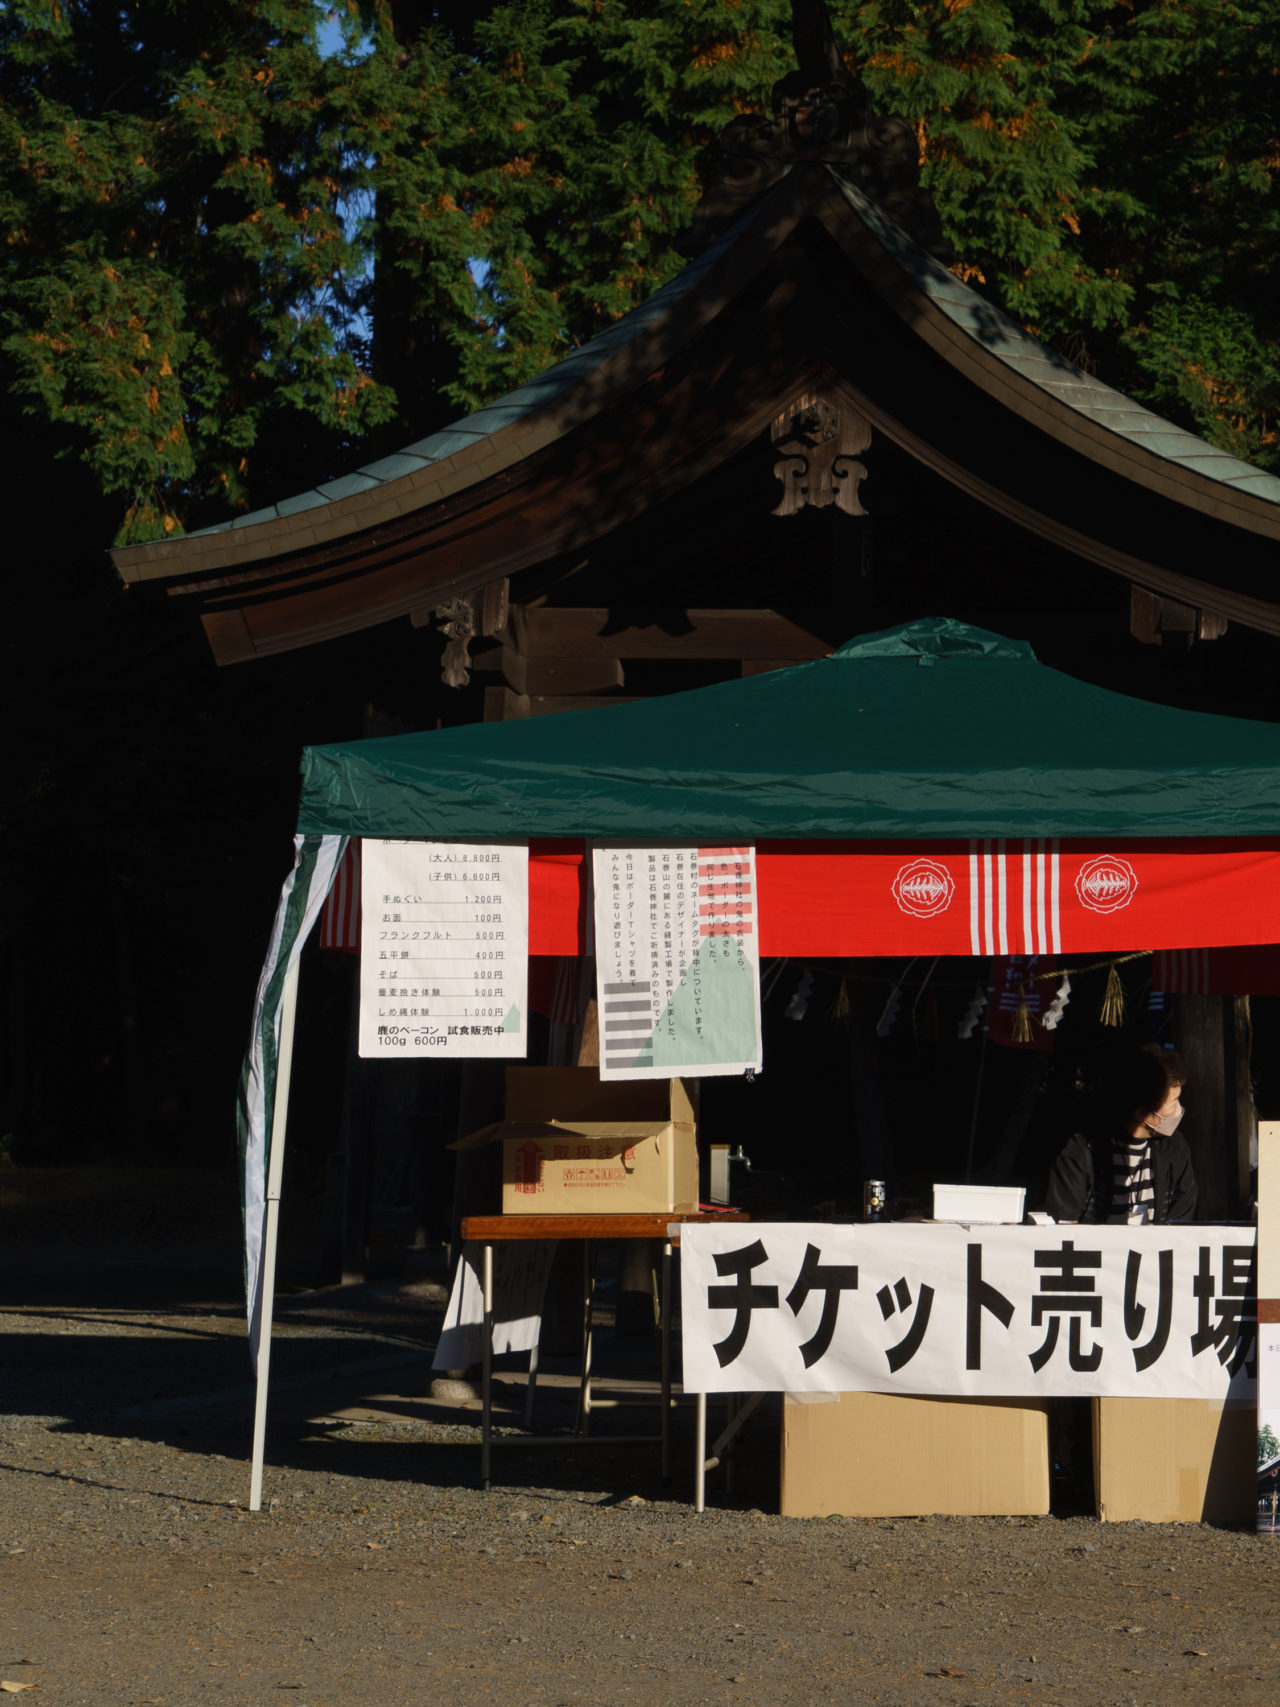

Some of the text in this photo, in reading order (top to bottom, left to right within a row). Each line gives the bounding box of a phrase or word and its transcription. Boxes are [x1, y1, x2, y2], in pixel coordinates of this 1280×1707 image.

[382, 913, 502, 923] お面 100円
[379, 931, 505, 941] フランクフルト 500円
[379, 950, 504, 960] 五平餅 400円
[378, 970, 503, 979] そば 500円
[378, 988, 504, 997] 蕎麦挽き体験 500円
[378, 1008, 430, 1017] しめ縄体験
[377, 1025, 506, 1036] 鹿のベーコン 試食販売中
[377, 1036, 448, 1047] 100g 600円
[706, 1238, 1258, 1380] チケット売り場
